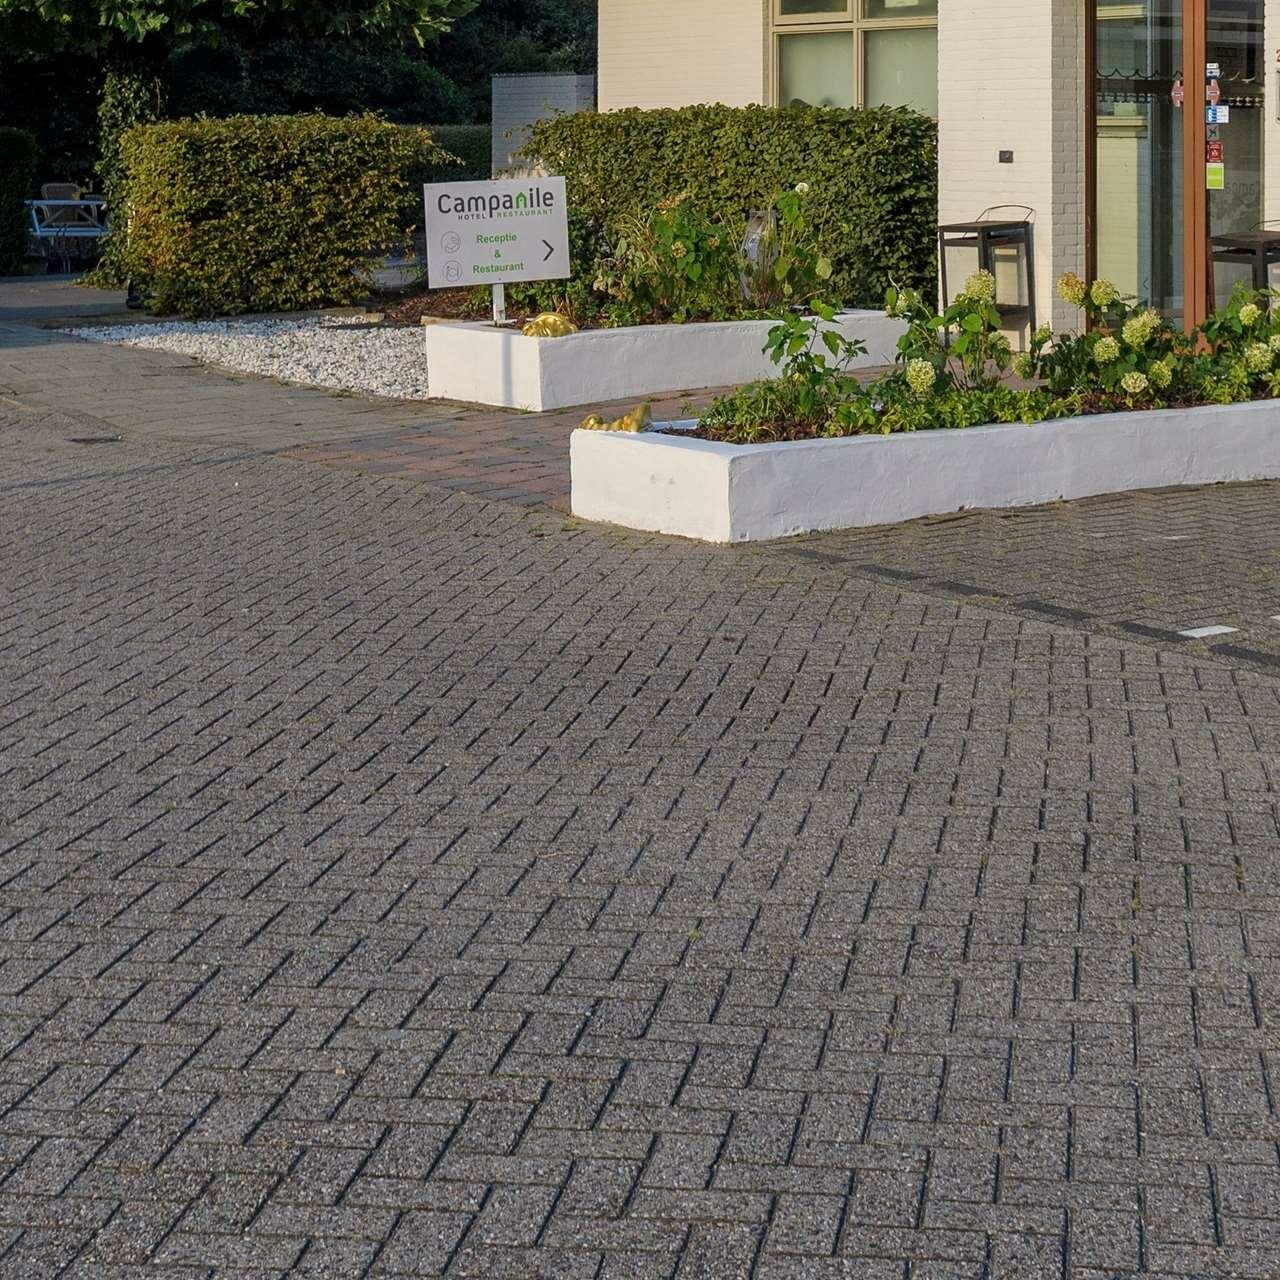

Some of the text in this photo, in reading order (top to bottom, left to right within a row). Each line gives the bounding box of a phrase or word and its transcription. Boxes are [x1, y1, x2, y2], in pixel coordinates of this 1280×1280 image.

[438, 187, 554, 218] Campanile
[496, 208, 553, 218] RESTAURANT
[476, 233, 517, 245] Receptie
[494, 249, 501, 258] &
[472, 262, 524, 274] Restaurant
